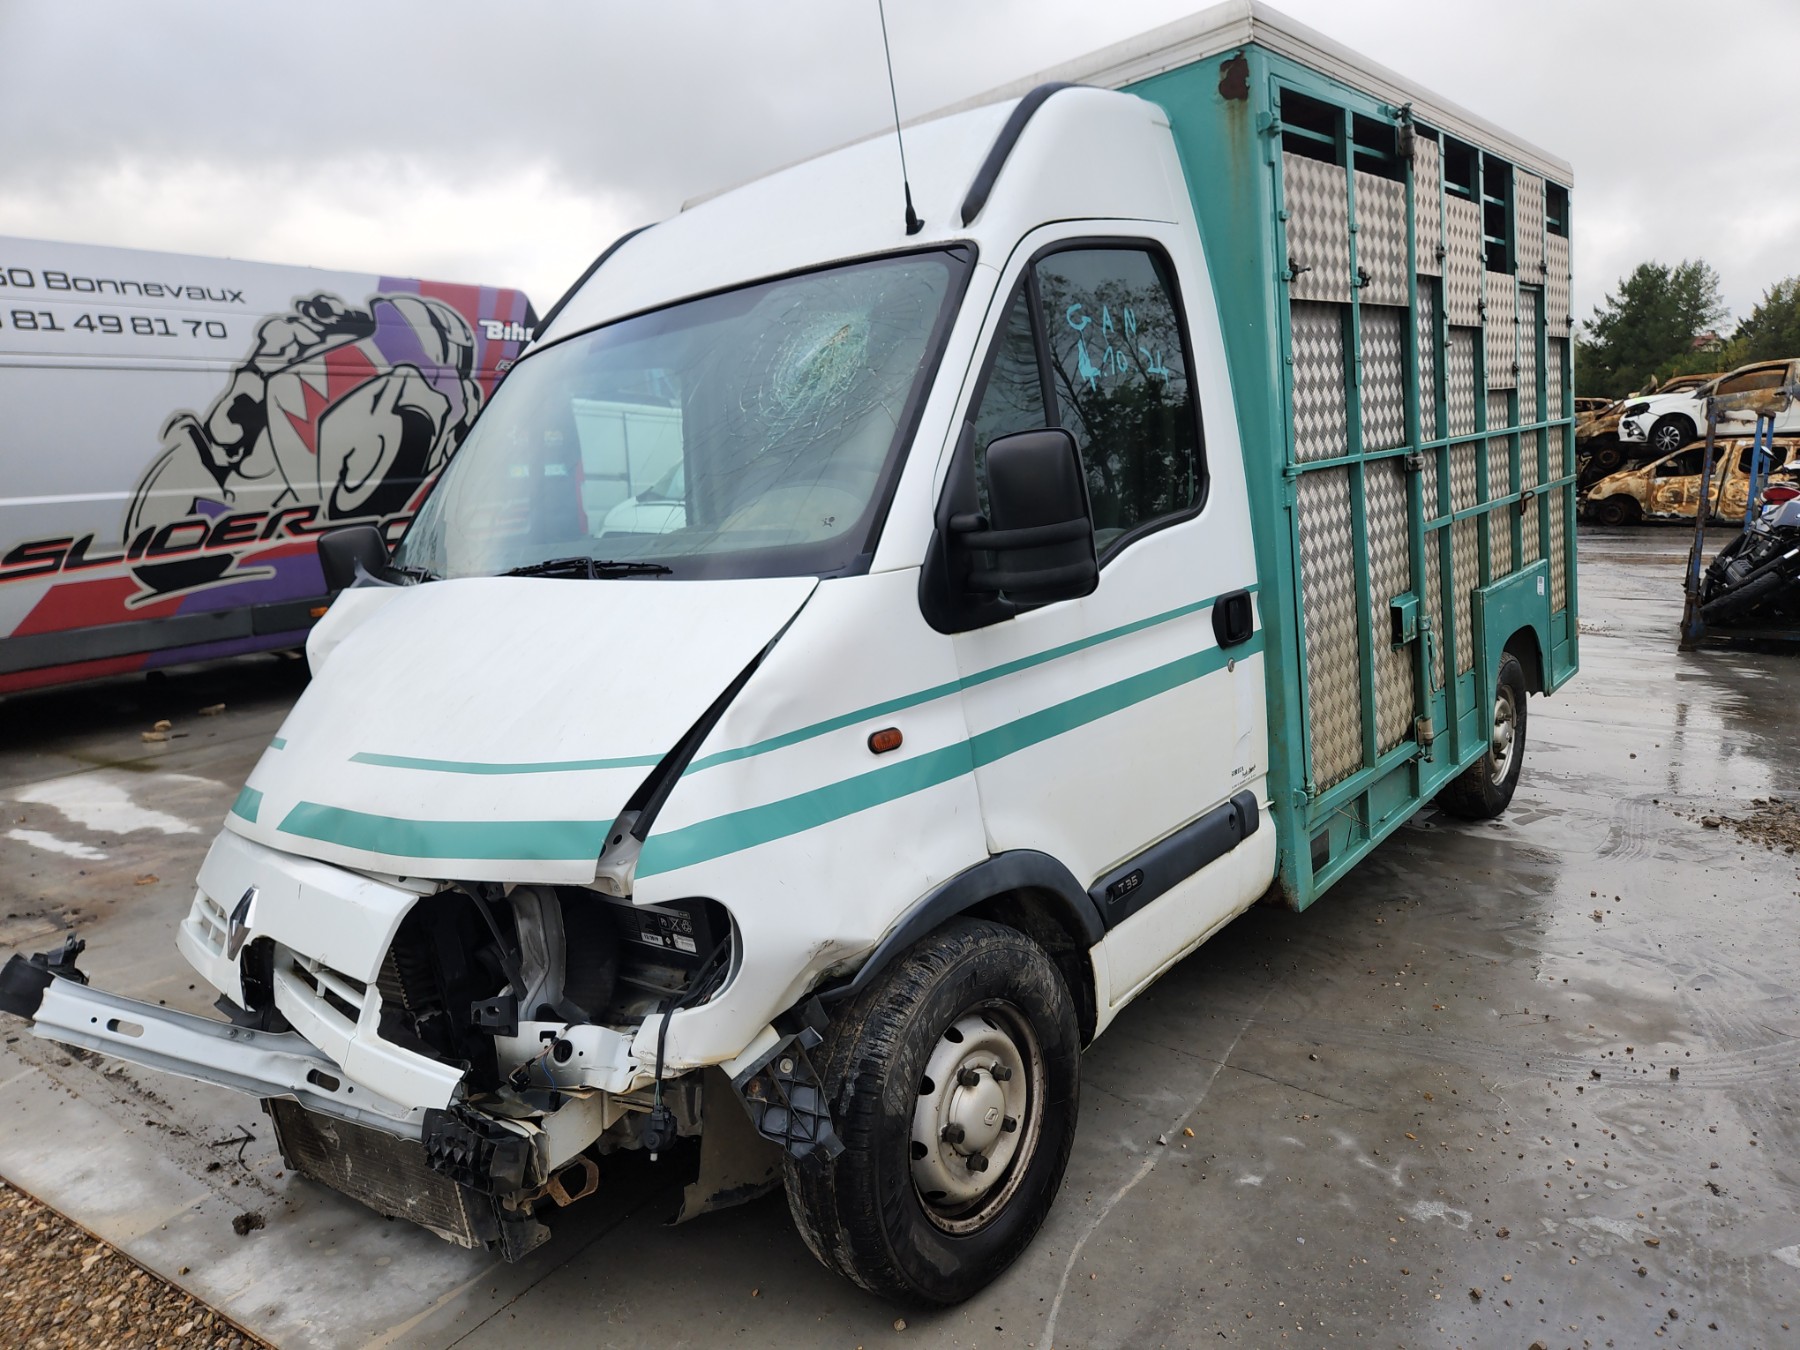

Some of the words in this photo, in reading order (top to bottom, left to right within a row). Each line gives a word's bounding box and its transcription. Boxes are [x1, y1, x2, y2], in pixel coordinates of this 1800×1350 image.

[43, 270, 246, 304] Bonnevaux
[11, 310, 65, 331] 81
[73, 314, 123, 334] 49
[130, 317, 178, 337] 81
[182, 319, 228, 339] 70
[0, 504, 321, 583] SLIDER
